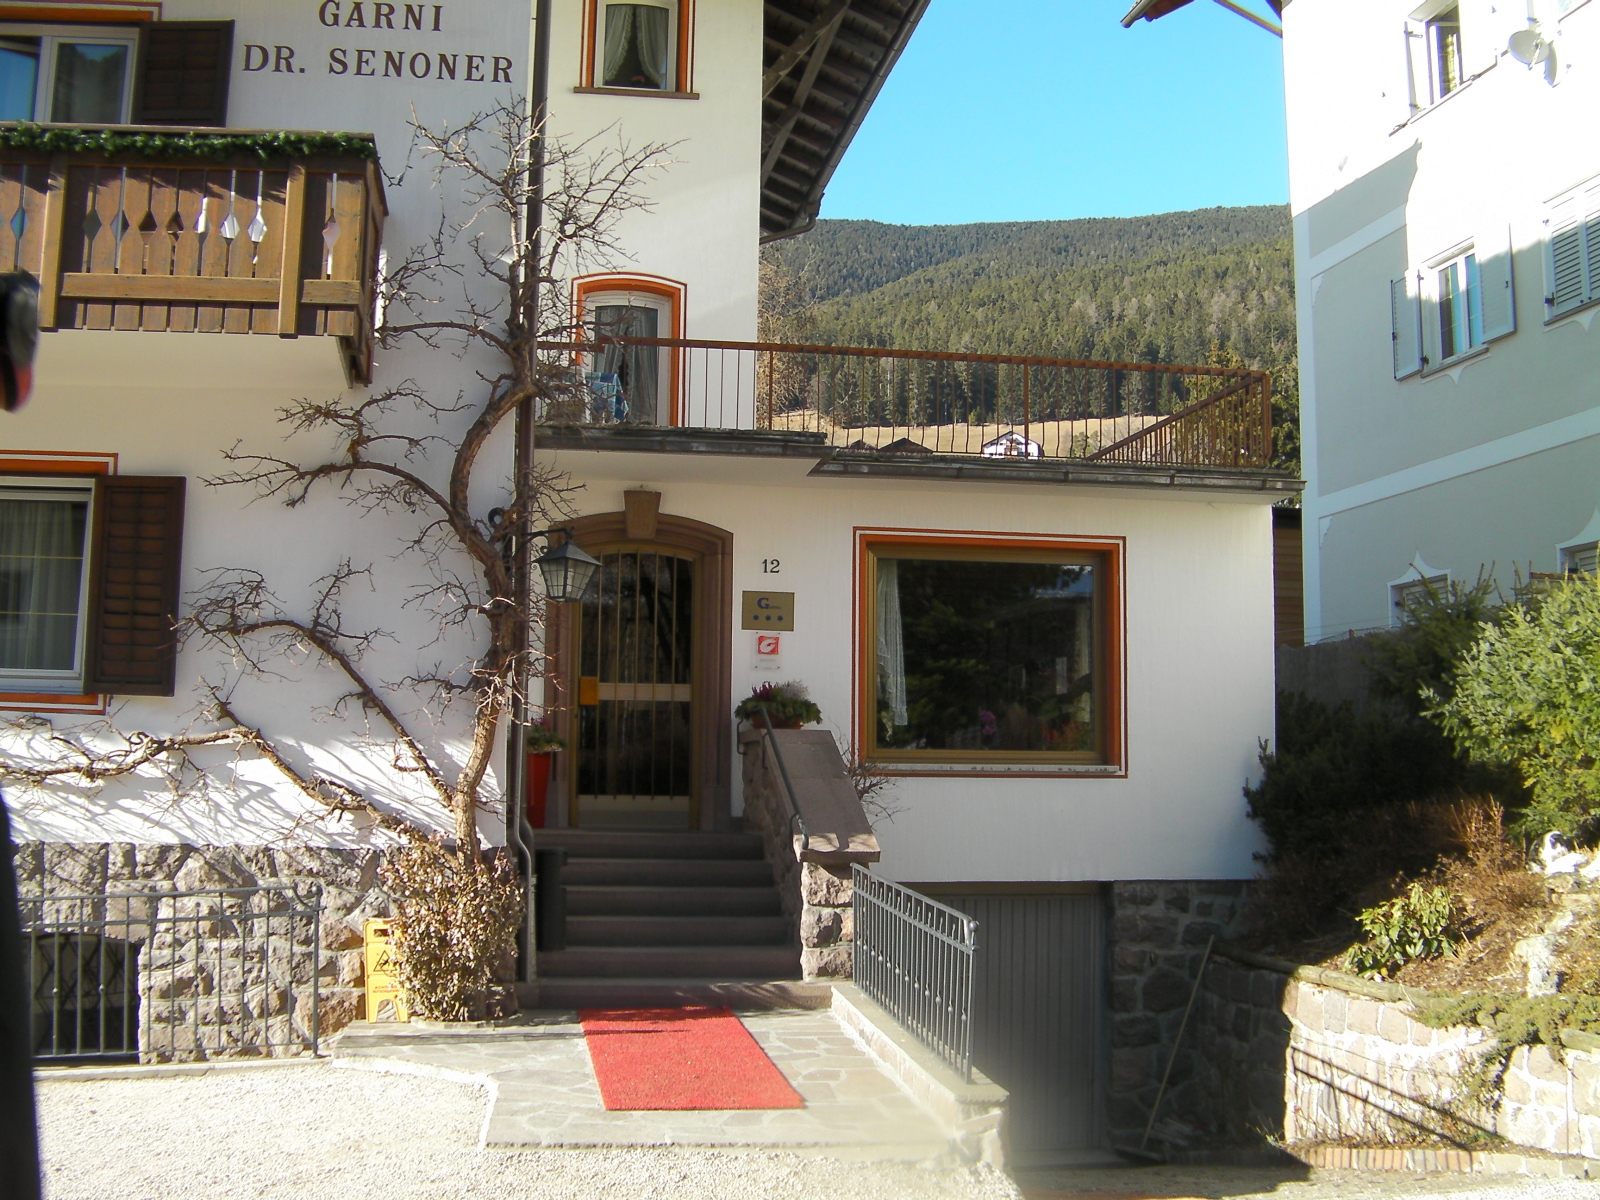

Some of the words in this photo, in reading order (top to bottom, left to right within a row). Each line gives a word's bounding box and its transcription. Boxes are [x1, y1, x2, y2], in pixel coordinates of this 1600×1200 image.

[318, 0, 443, 32] GARNI
[242, 44, 306, 74] DR.
[328, 47, 513, 84] SENONER
[761, 558, 780, 573] 12
